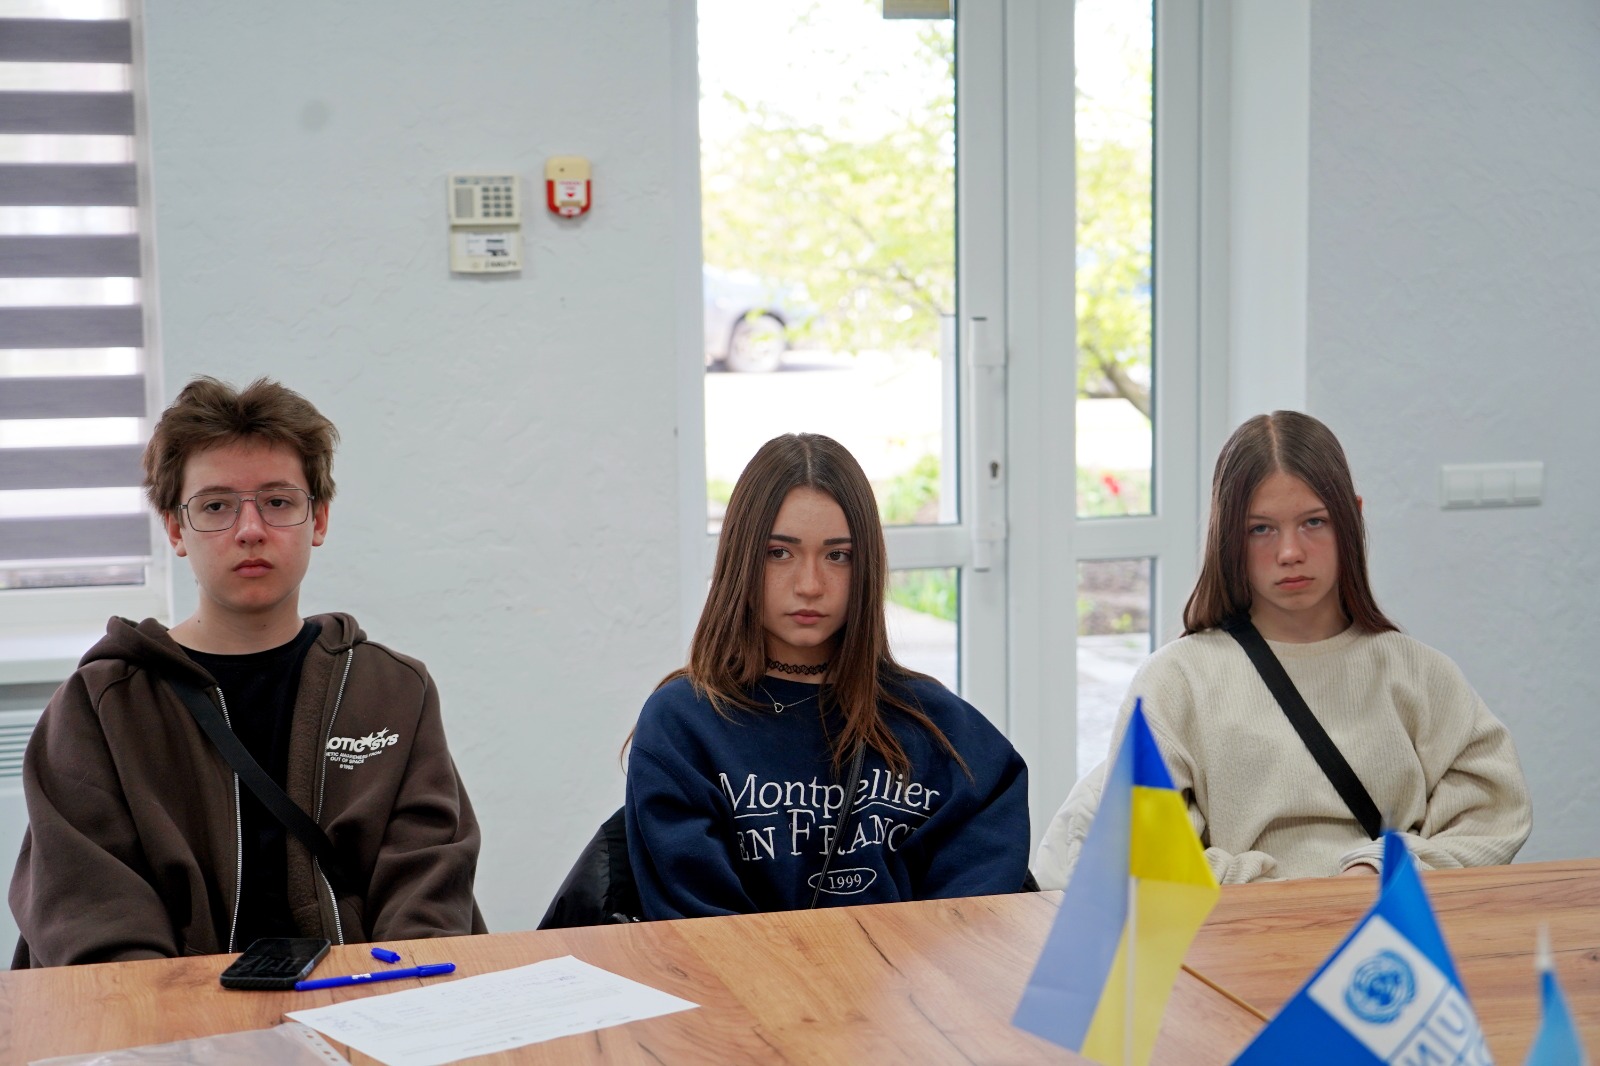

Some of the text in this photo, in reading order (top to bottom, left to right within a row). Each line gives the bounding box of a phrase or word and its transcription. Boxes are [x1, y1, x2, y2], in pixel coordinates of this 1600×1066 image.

[719, 768, 940, 819] Montpellier
[737, 808, 918, 861] EN FRANC
[829, 873, 862, 890] 1999
